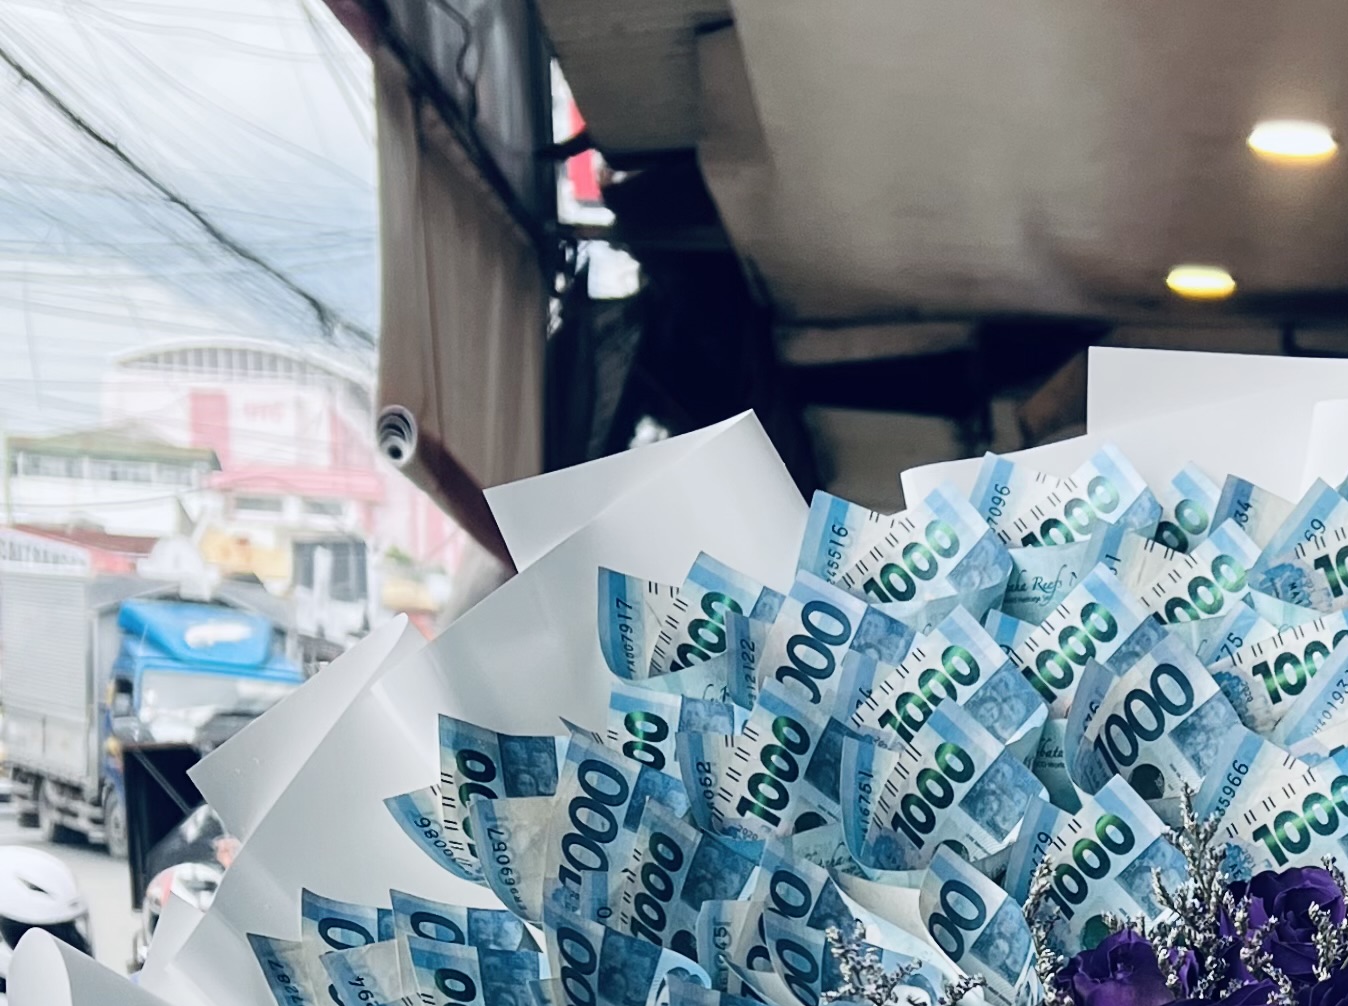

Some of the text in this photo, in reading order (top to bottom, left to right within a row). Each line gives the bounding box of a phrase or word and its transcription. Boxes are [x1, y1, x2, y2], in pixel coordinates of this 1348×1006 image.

[862, 519, 961, 604] 1000
[1151, 554, 1249, 625] 000
[775, 600, 852, 704] 000
[1021, 602, 1118, 704] 1000
[623, 711, 670, 771] 00
[736, 715, 811, 827] 1000
[1095, 664, 1195, 775] 1000
[557, 758, 630, 895] 1000
[893, 742, 975, 849] 1000
[630, 831, 684, 947] 1000
[1043, 813, 1136, 920] 1000
[927, 879, 987, 964] 00
